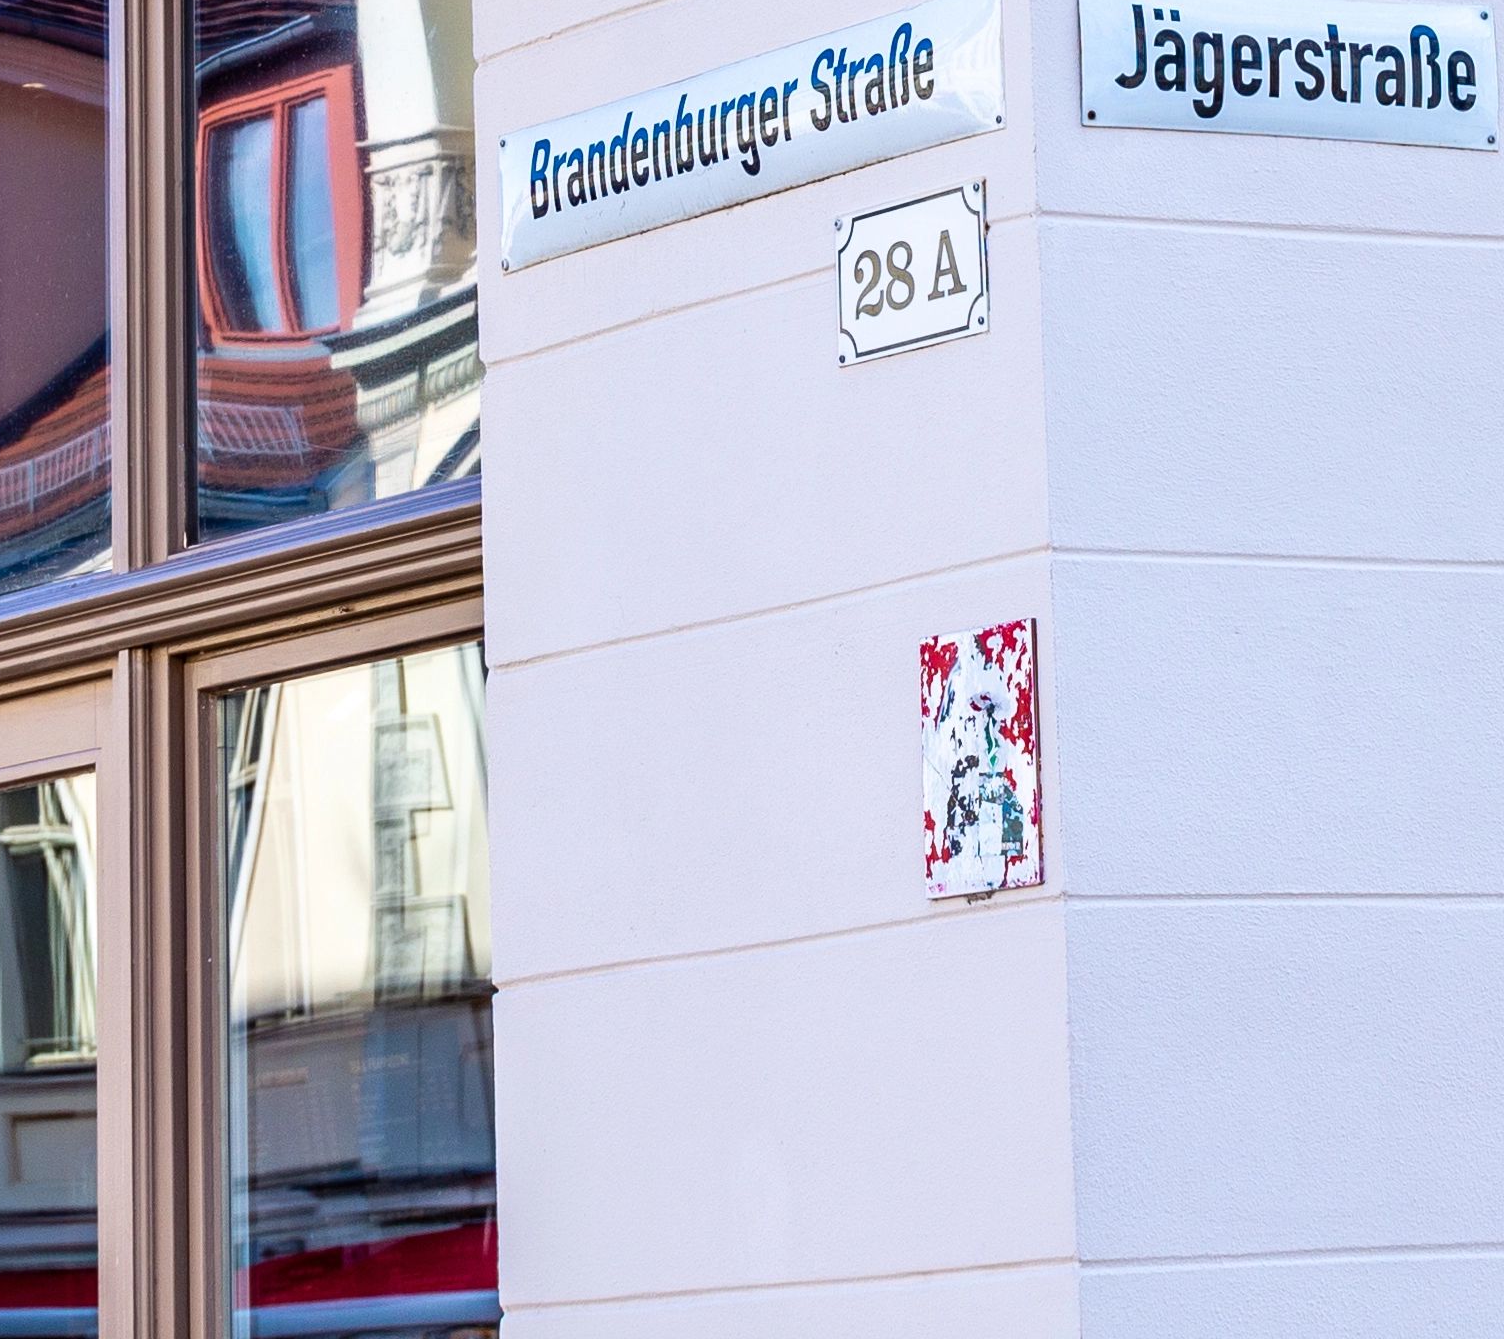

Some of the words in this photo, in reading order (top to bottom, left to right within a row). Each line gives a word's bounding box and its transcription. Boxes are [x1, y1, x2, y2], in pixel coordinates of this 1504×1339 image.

[1113, 3, 1478, 120] Jägerstraße
[528, 76, 801, 221] Brandenburger
[810, 21, 936, 132] Straße
[852, 240, 916, 321] 28
[926, 229, 969, 303] A
